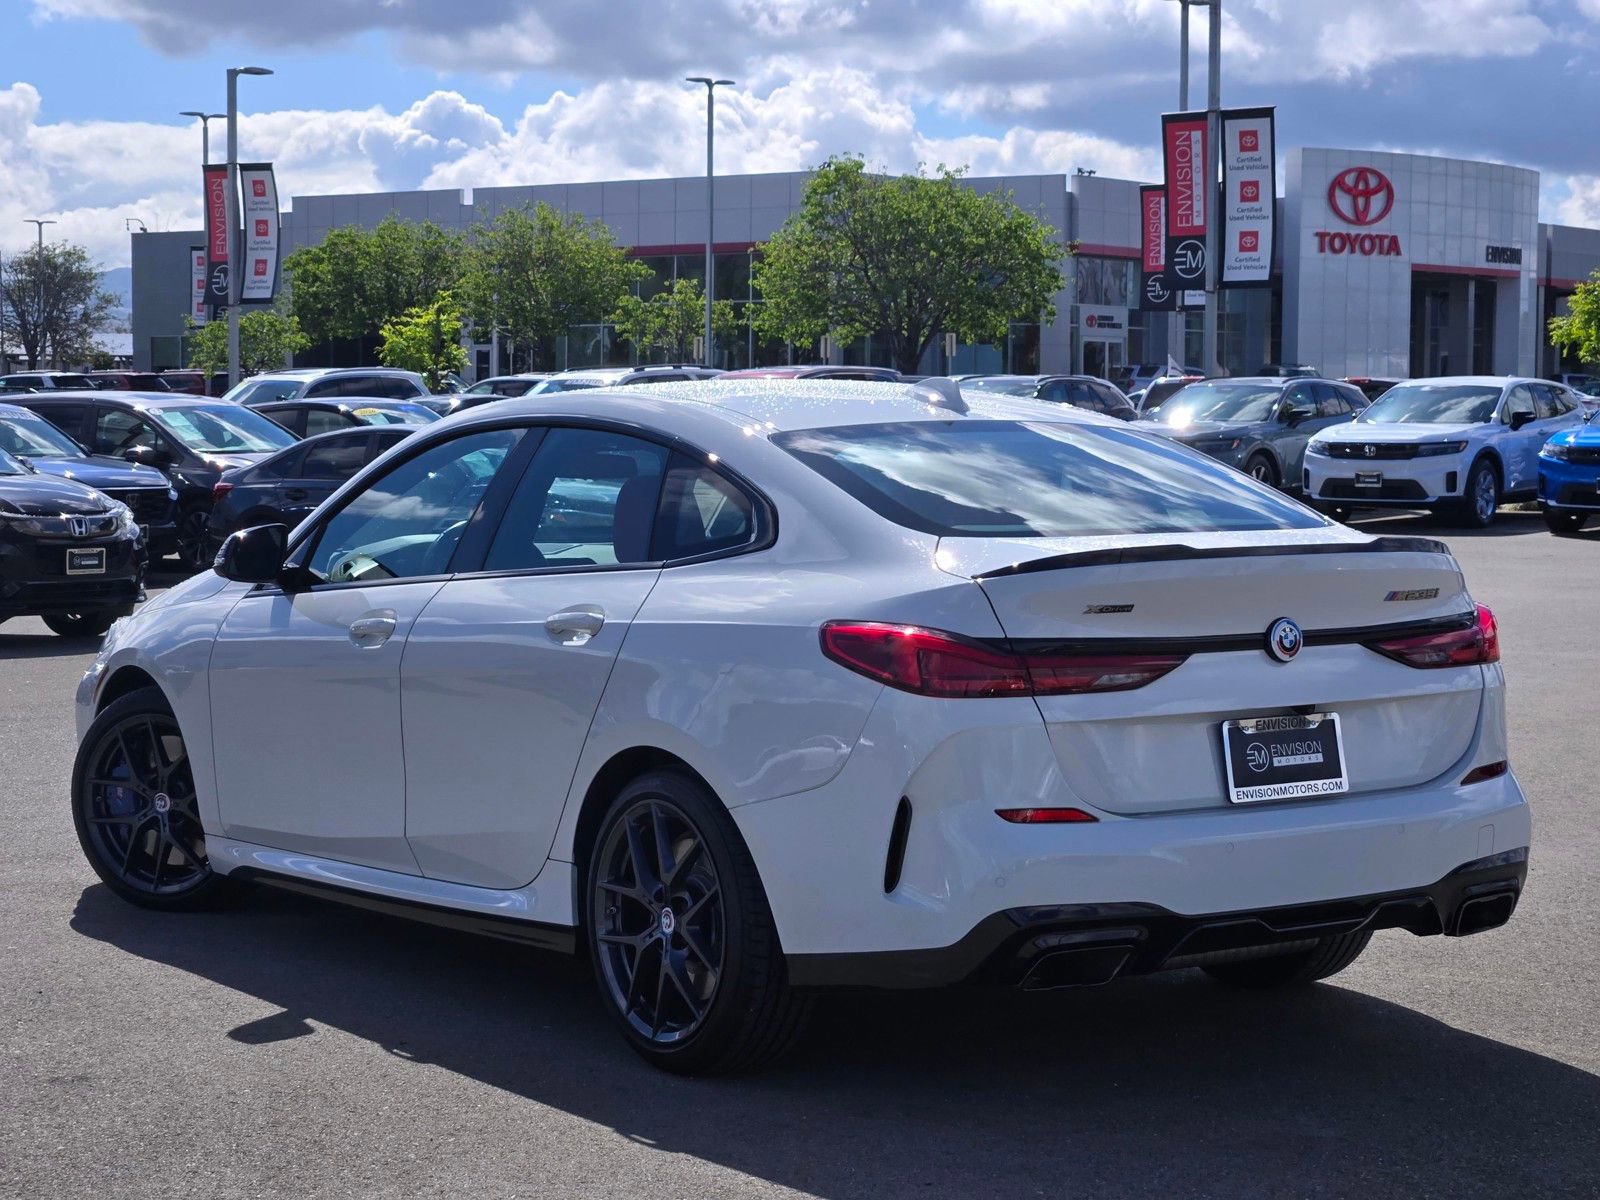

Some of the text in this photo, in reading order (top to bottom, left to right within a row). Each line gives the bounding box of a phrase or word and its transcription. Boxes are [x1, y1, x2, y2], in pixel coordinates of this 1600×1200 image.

[1246, 163, 1269, 171] Vehicles
[1175, 130, 1192, 228] ENVISION
[212, 178, 226, 255] ENVISION
[1149, 196, 1161, 266] ENVISION
[1314, 232, 1402, 257] TOYOTA
[1255, 717, 1307, 731] ENVISION
[1270, 740, 1322, 757] ENVISION
[1277, 755, 1320, 764] MOTORS
[1236, 781, 1344, 800] ENVISIONMOTORS.COM
